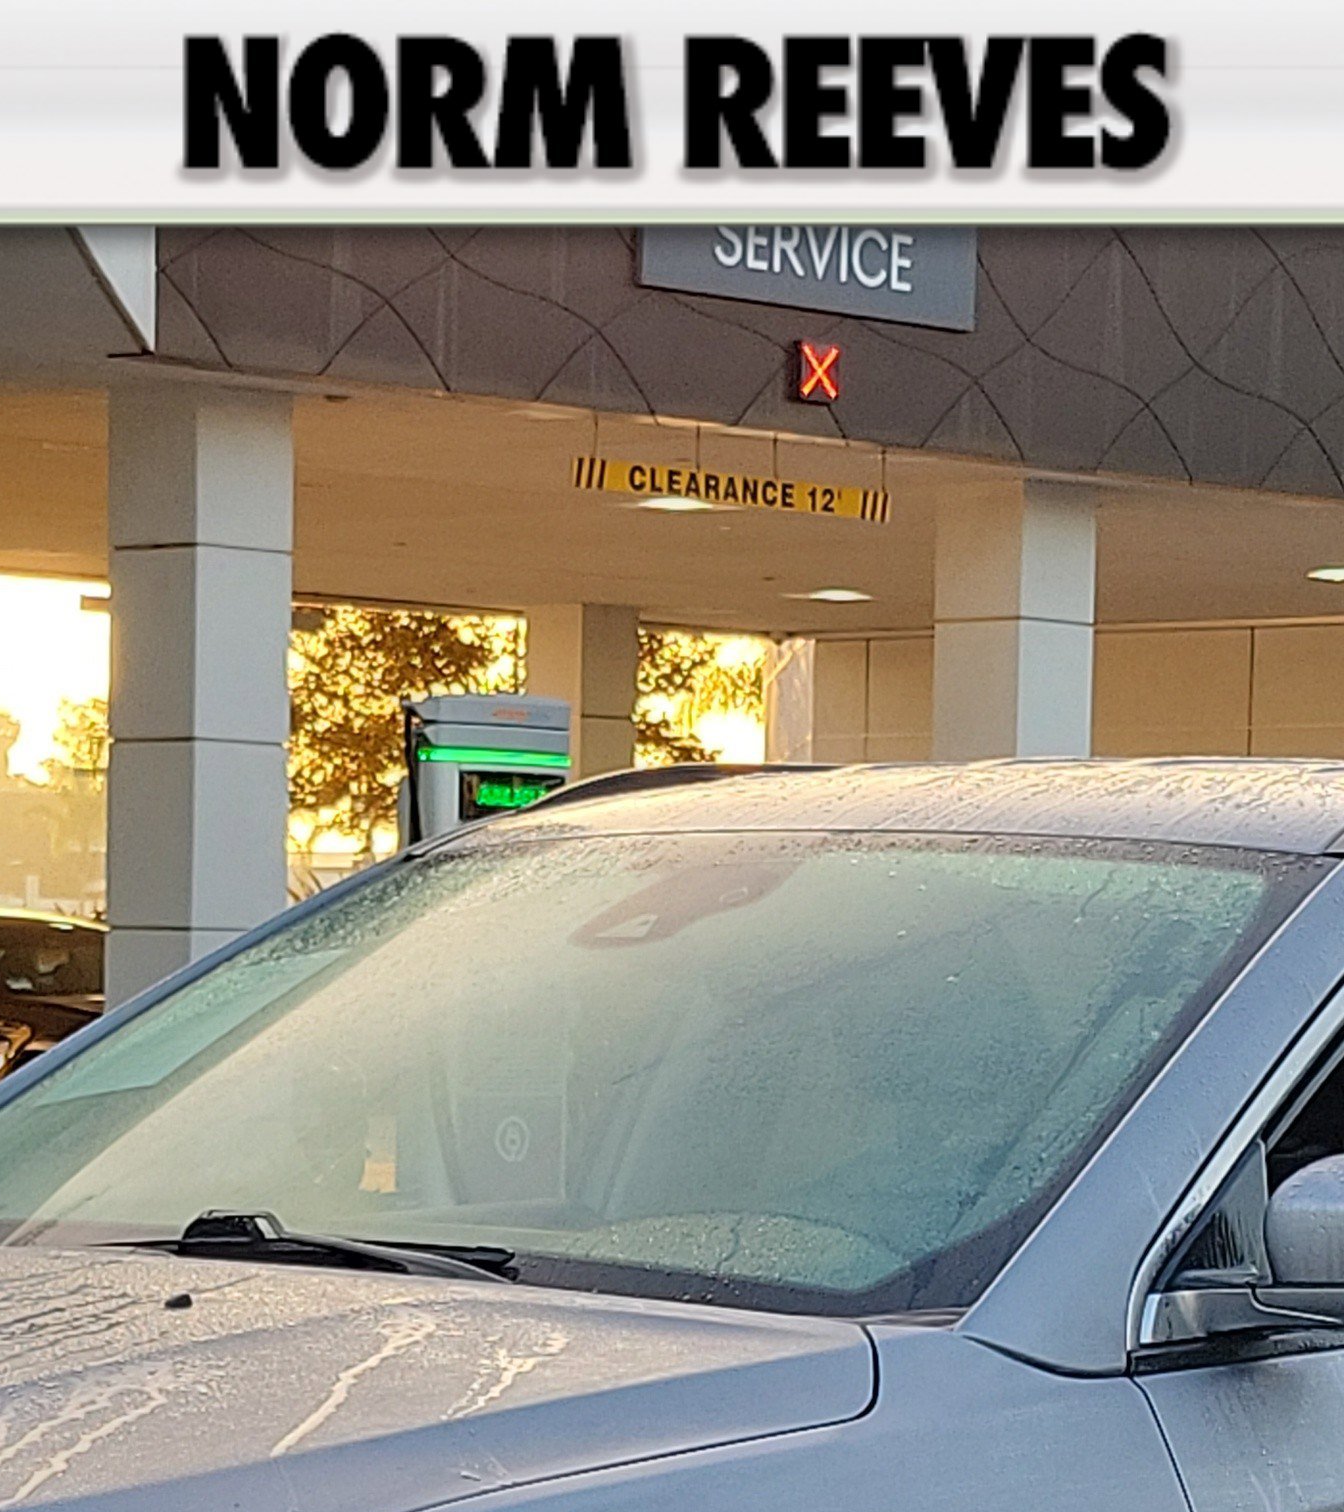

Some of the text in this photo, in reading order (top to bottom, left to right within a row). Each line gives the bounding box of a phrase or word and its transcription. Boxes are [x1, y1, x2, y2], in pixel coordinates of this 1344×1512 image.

[713, 226, 914, 292] SERVICE
[628, 465, 843, 514] CLEARANCE 12'
